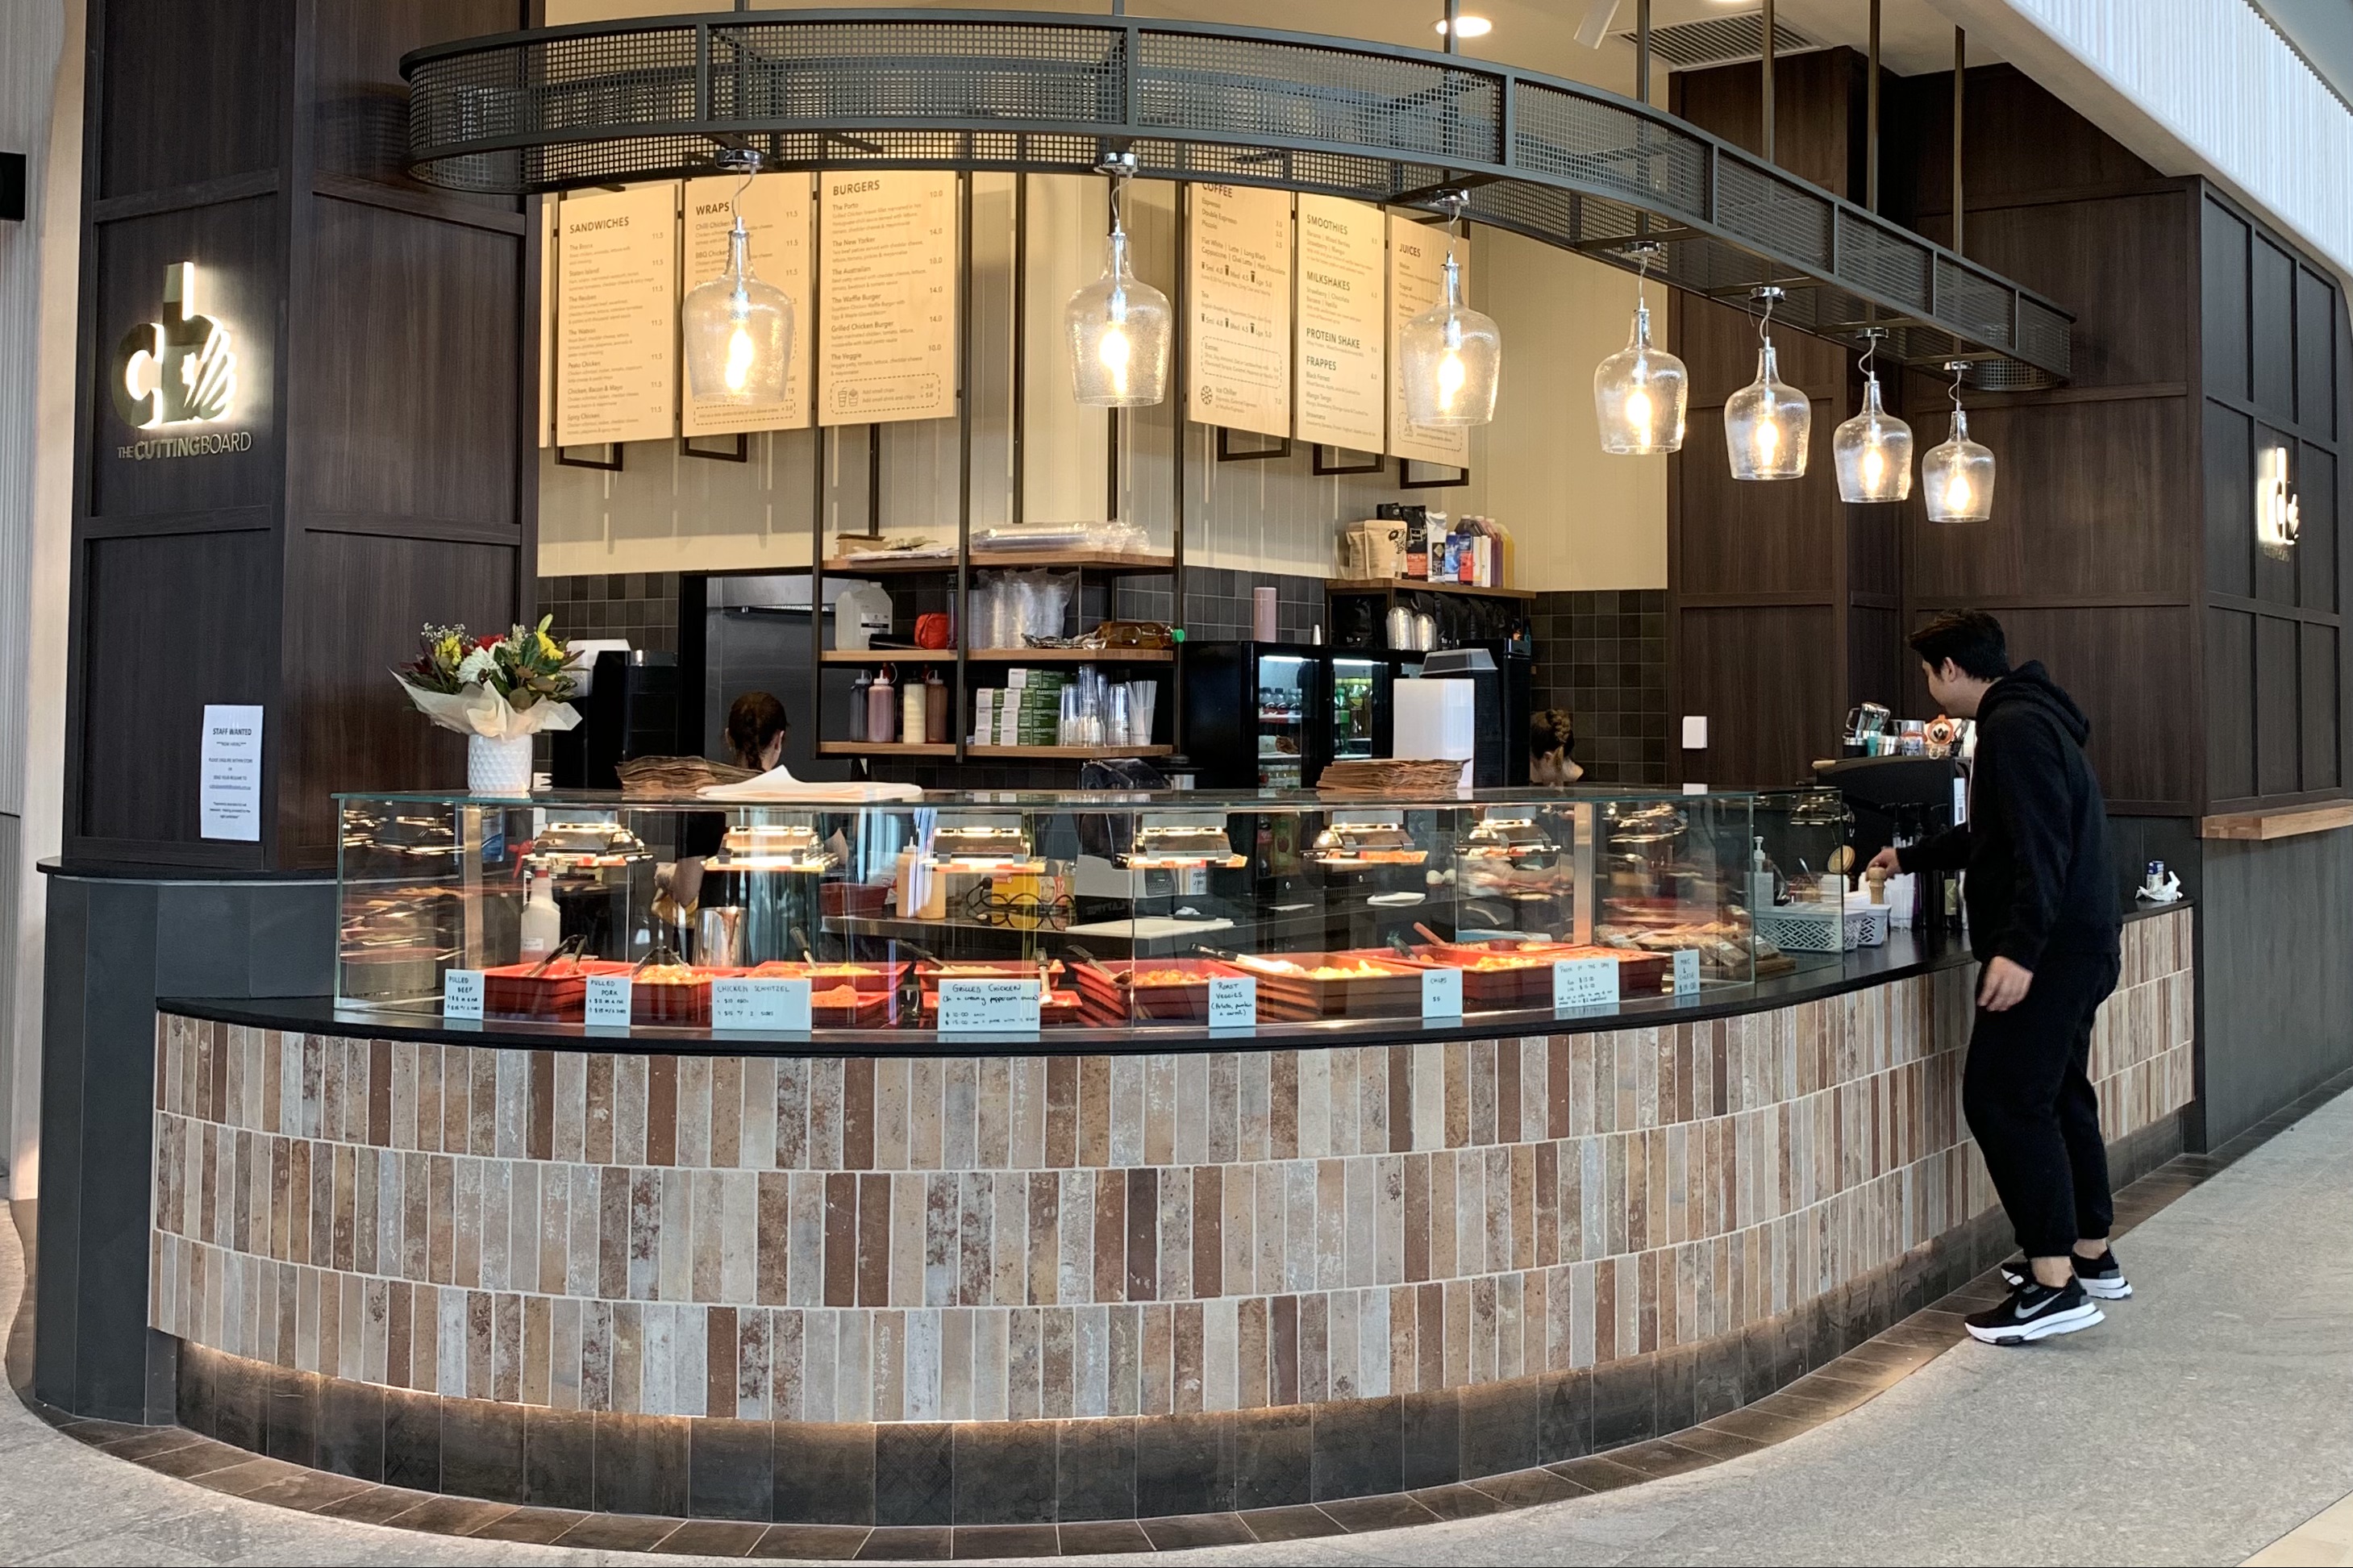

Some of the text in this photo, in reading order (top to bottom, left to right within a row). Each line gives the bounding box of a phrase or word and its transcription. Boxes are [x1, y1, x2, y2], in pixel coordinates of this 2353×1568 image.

[833, 180, 880, 196] BURGERS
[1201, 182, 1233, 198] COFFEE
[1201, 197, 1221, 209] Espresso
[696, 202, 730, 216] WRAPS
[1201, 208, 1238, 225] Double Espresso
[568, 216, 630, 234] SANDWICHES
[710, 220, 731, 228] Chicken
[1306, 214, 1348, 235] SMOOTHIES
[857, 236, 876, 244] Yorker
[1201, 236, 1266, 260] Flat White Latte Long Black
[1399, 243, 1421, 258] JUICES
[695, 250, 707, 259] BBQ
[1201, 246, 1227, 260] Cappuccino
[1232, 254, 1242, 264] Chai
[1242, 258, 1252, 267] Latte
[1265, 264, 1286, 276] Chocolate
[843, 266, 872, 274] Australian
[1306, 270, 1351, 292] MILKSHAKES
[843, 294, 860, 302] Waffle
[862, 293, 881, 302] Burger
[831, 321, 894, 332] Grilled Chicken Burger
[1306, 326, 1336, 343] PROTEIN
[1338, 335, 1361, 349] SHAKE
[842, 352, 862, 361] Veggie
[581, 360, 601, 368] Chicken
[1306, 356, 1336, 371] FRAPPES
[567, 412, 600, 422] Spicy Chicken
[117, 446, 135, 460] THE
[448, 975, 469, 984] PULLED
[590, 979, 615, 988] PULLED
[1430, 976, 1447, 984] CHIPS
[717, 985, 790, 993] CHICKEN SCHNITZEL
[1218, 981, 1239, 991] ROAST
